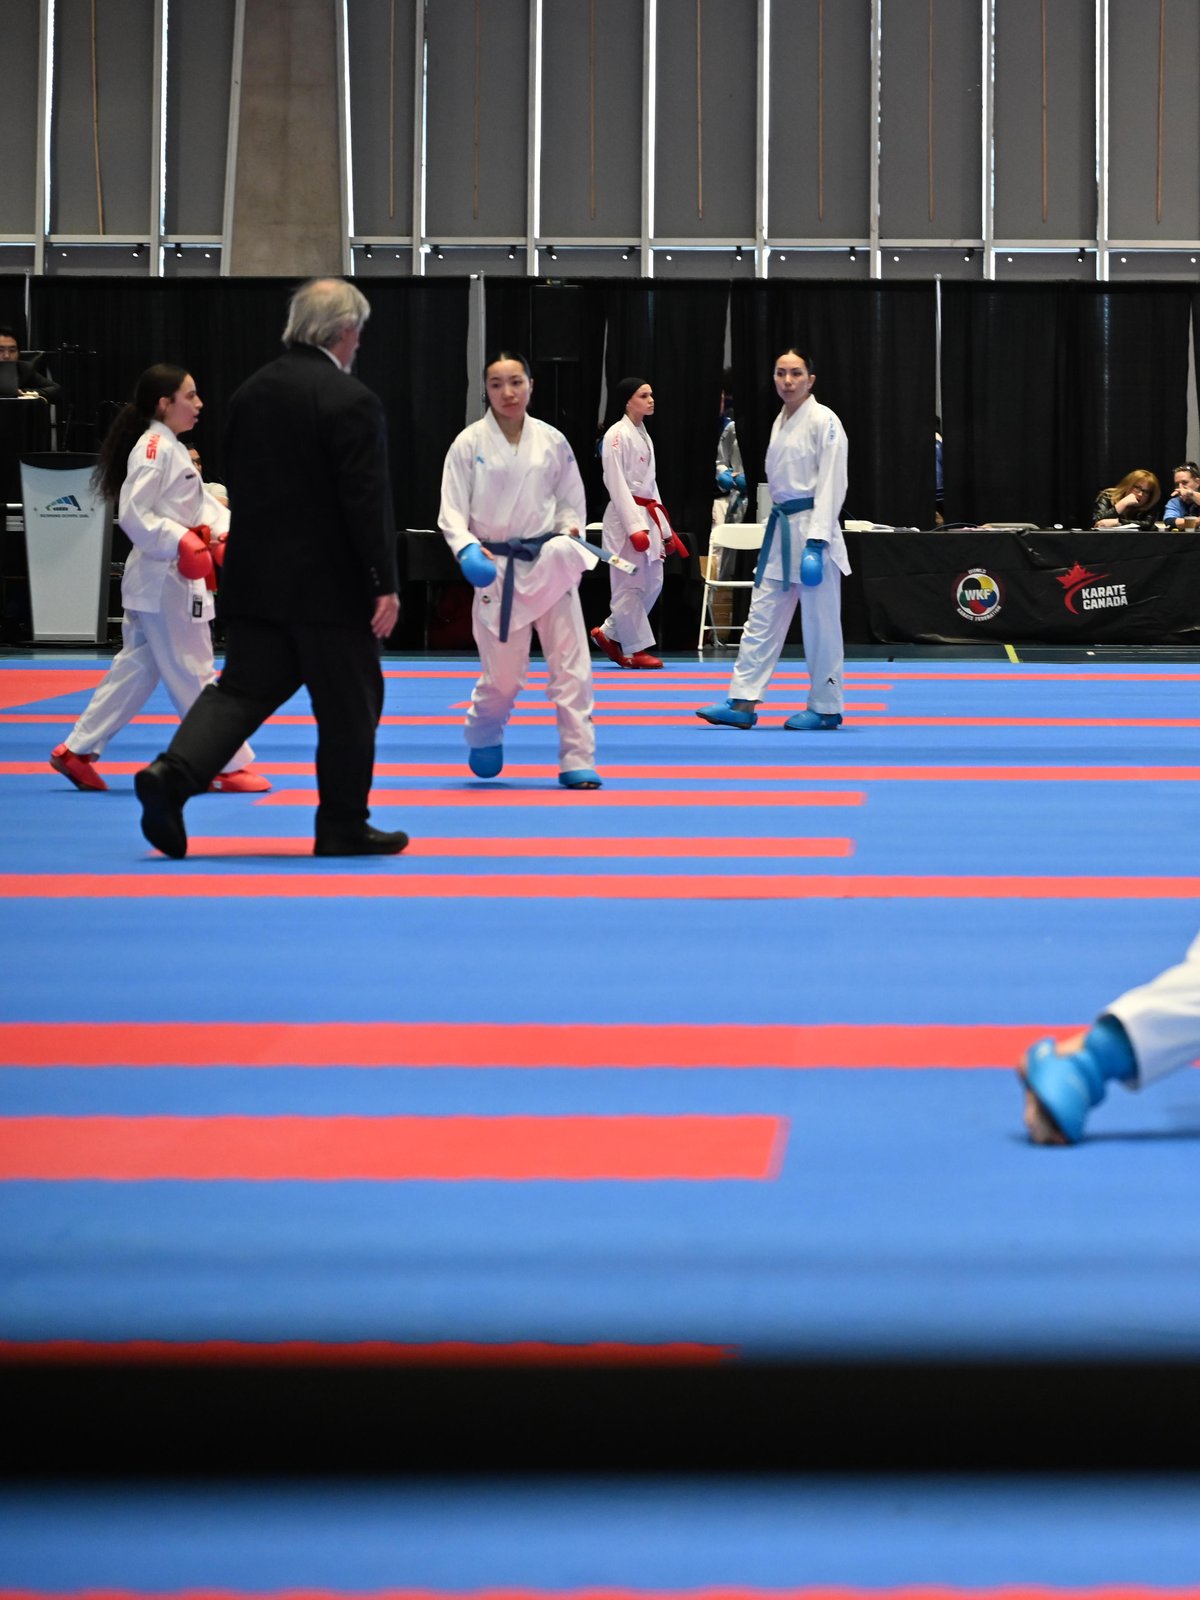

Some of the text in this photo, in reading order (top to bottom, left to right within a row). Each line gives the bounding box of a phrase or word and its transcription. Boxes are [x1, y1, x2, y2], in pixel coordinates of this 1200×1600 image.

[964, 589, 991, 601] WKF
[1081, 584, 1127, 600] KARATE
[1082, 595, 1128, 610] CANADA
